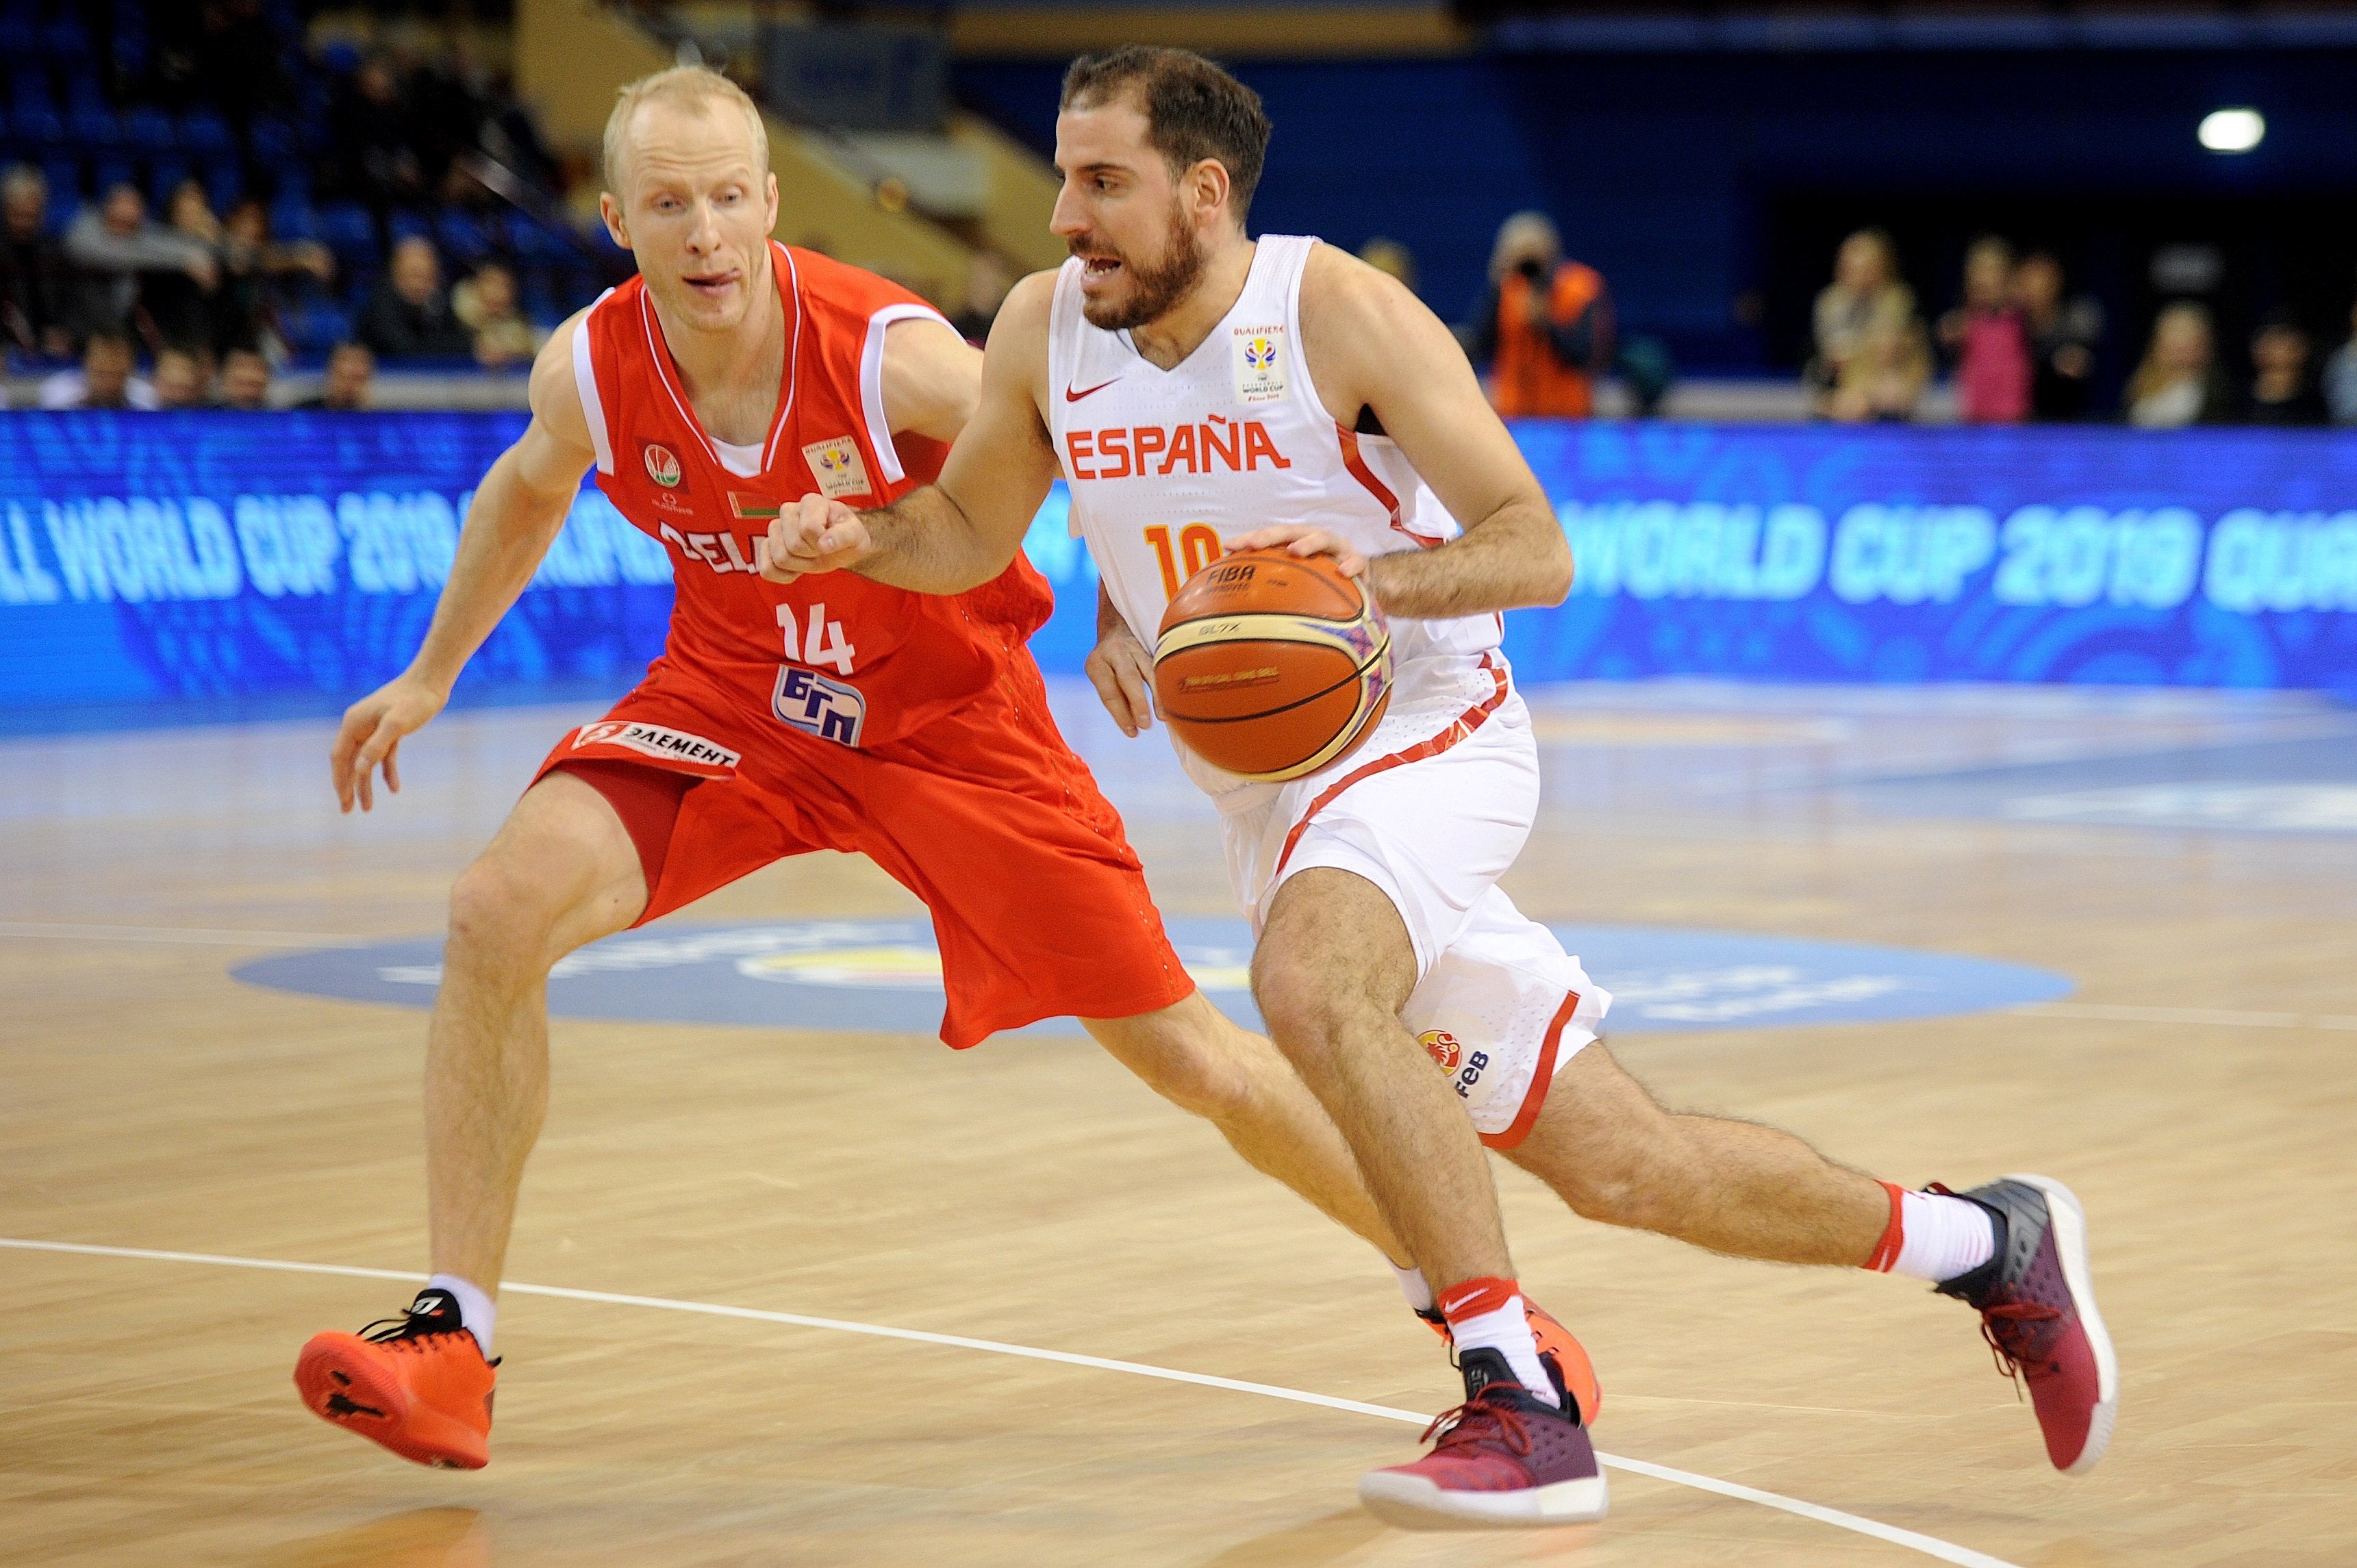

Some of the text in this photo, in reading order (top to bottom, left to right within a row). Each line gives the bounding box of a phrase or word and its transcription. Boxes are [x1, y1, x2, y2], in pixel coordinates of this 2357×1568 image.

[1066, 414, 1291, 480] ESPAÑA
[42, 494, 238, 603] WORLD
[234, 492, 340, 598] CUP
[1143, 522, 1224, 605] 10
[1206, 564, 1257, 586] FIBA
[1559, 498, 1828, 601] WORLD
[1828, 501, 1999, 606] CUP
[1992, 503, 2204, 608] 2019
[776, 602, 855, 676] 14
[624, 726, 734, 766] ЭЛЕМЕНТ
